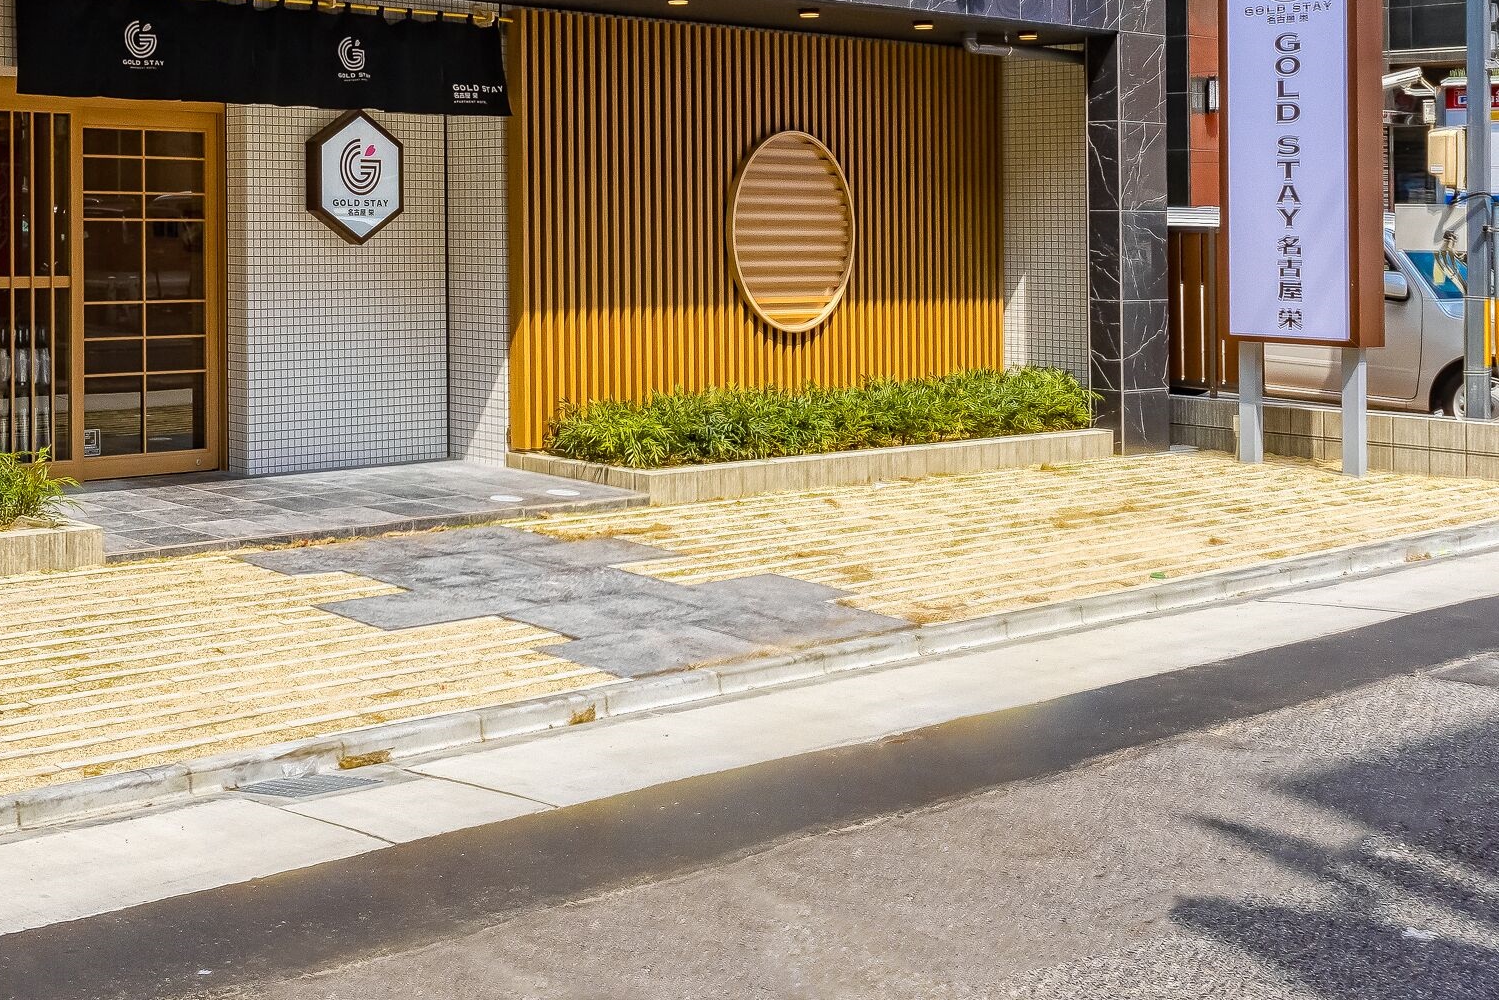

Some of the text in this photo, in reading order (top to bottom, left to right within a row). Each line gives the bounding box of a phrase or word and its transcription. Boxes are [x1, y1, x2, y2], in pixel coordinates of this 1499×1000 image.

[1244, 0, 1332, 17] GOLD STAY
[1267, 13, 1296, 24] 名古屋
[143, 59, 165, 67] STAY
[452, 83, 503, 93] GOLD STAY
[1274, 32, 1304, 331] GOLD STAY 名古屋 栄
[332, 198, 389, 208] GOLD STAY
